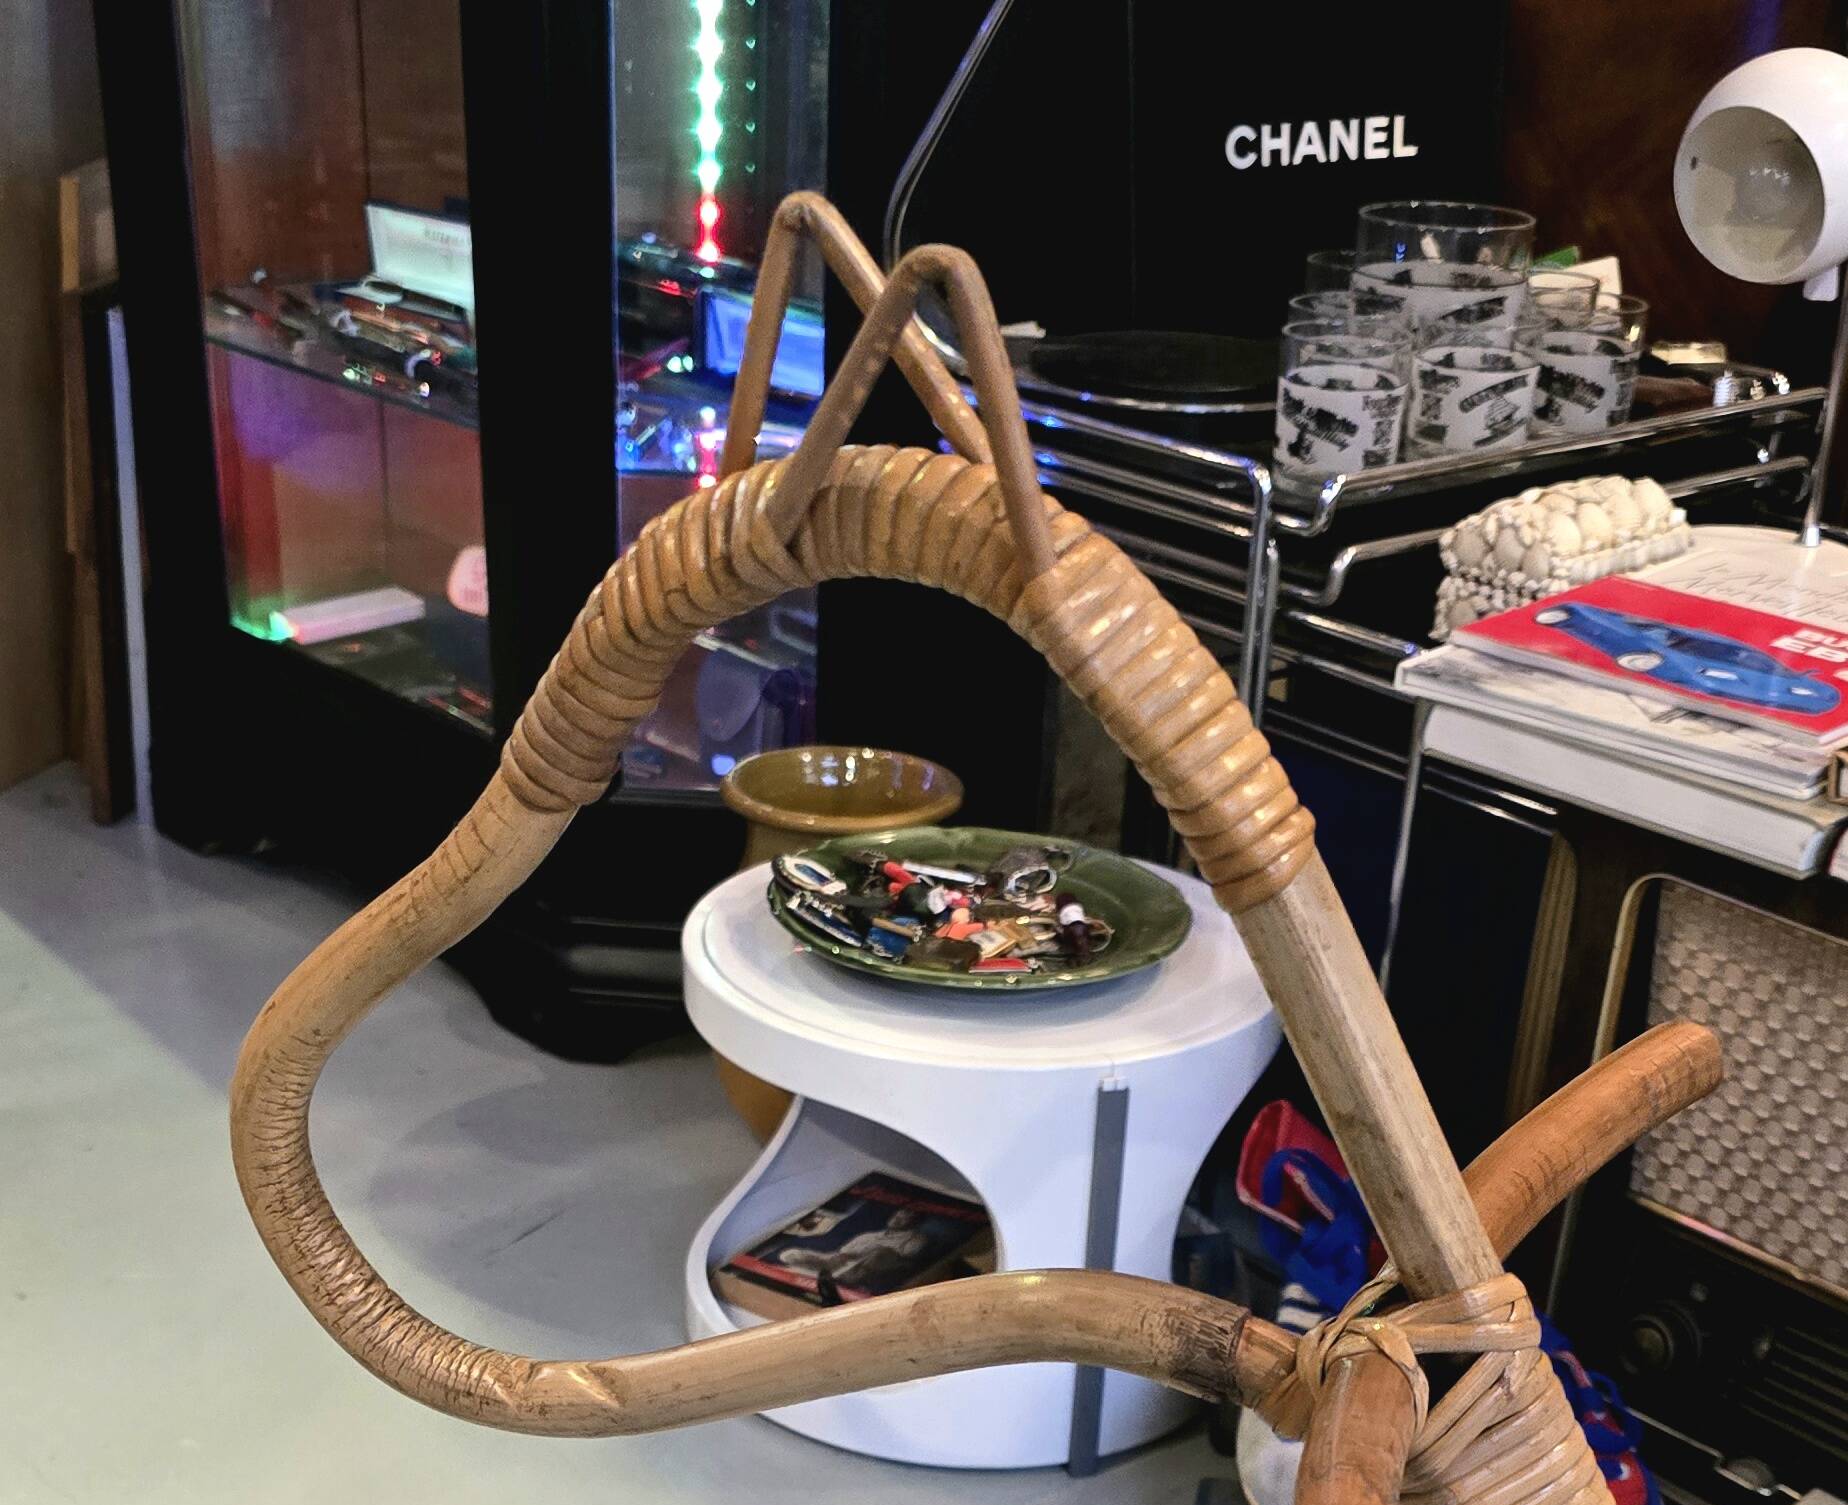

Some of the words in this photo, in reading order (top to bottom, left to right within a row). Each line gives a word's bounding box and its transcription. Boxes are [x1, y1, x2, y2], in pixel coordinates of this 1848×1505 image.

[1224, 115, 1419, 170] CHANEL
[1768, 635, 1848, 663] EB
[1793, 629, 1848, 649] BU
